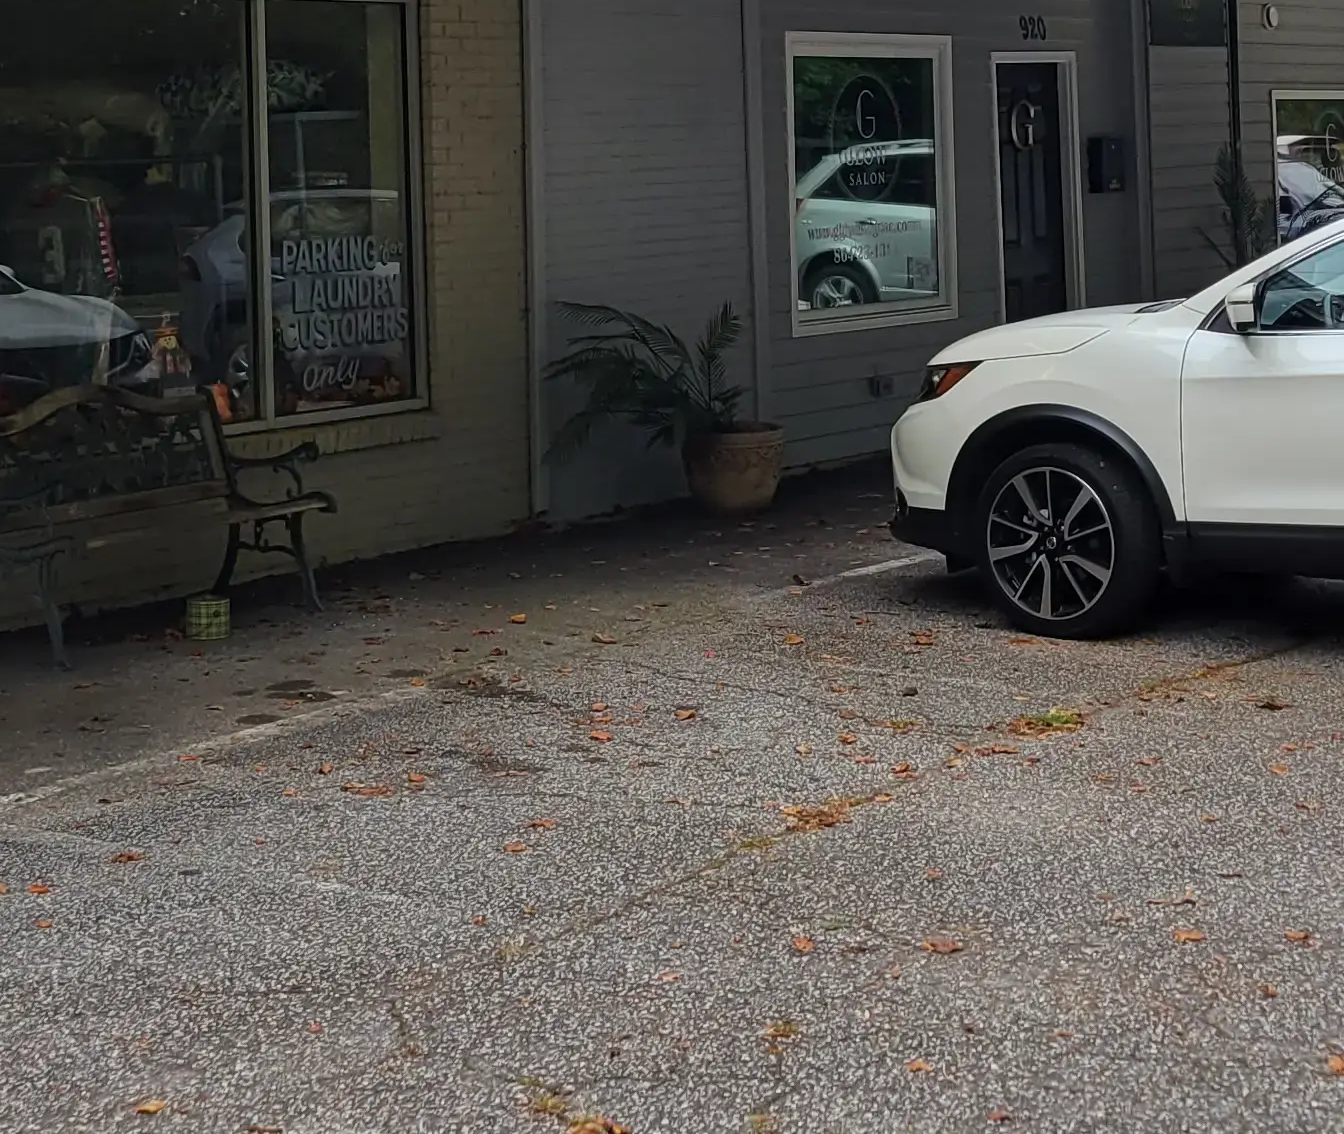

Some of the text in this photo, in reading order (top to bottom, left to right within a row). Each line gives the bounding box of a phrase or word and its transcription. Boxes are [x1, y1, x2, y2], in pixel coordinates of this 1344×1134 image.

[1019, 15, 1047, 41] 920
[856, 89, 876, 139] G
[1010, 99, 1036, 151] G
[849, 171, 887, 186] SALON
[281, 235, 377, 274] PARKING
[292, 272, 402, 314] LAUNDRY
[280, 308, 409, 350] CUSTOMERS
